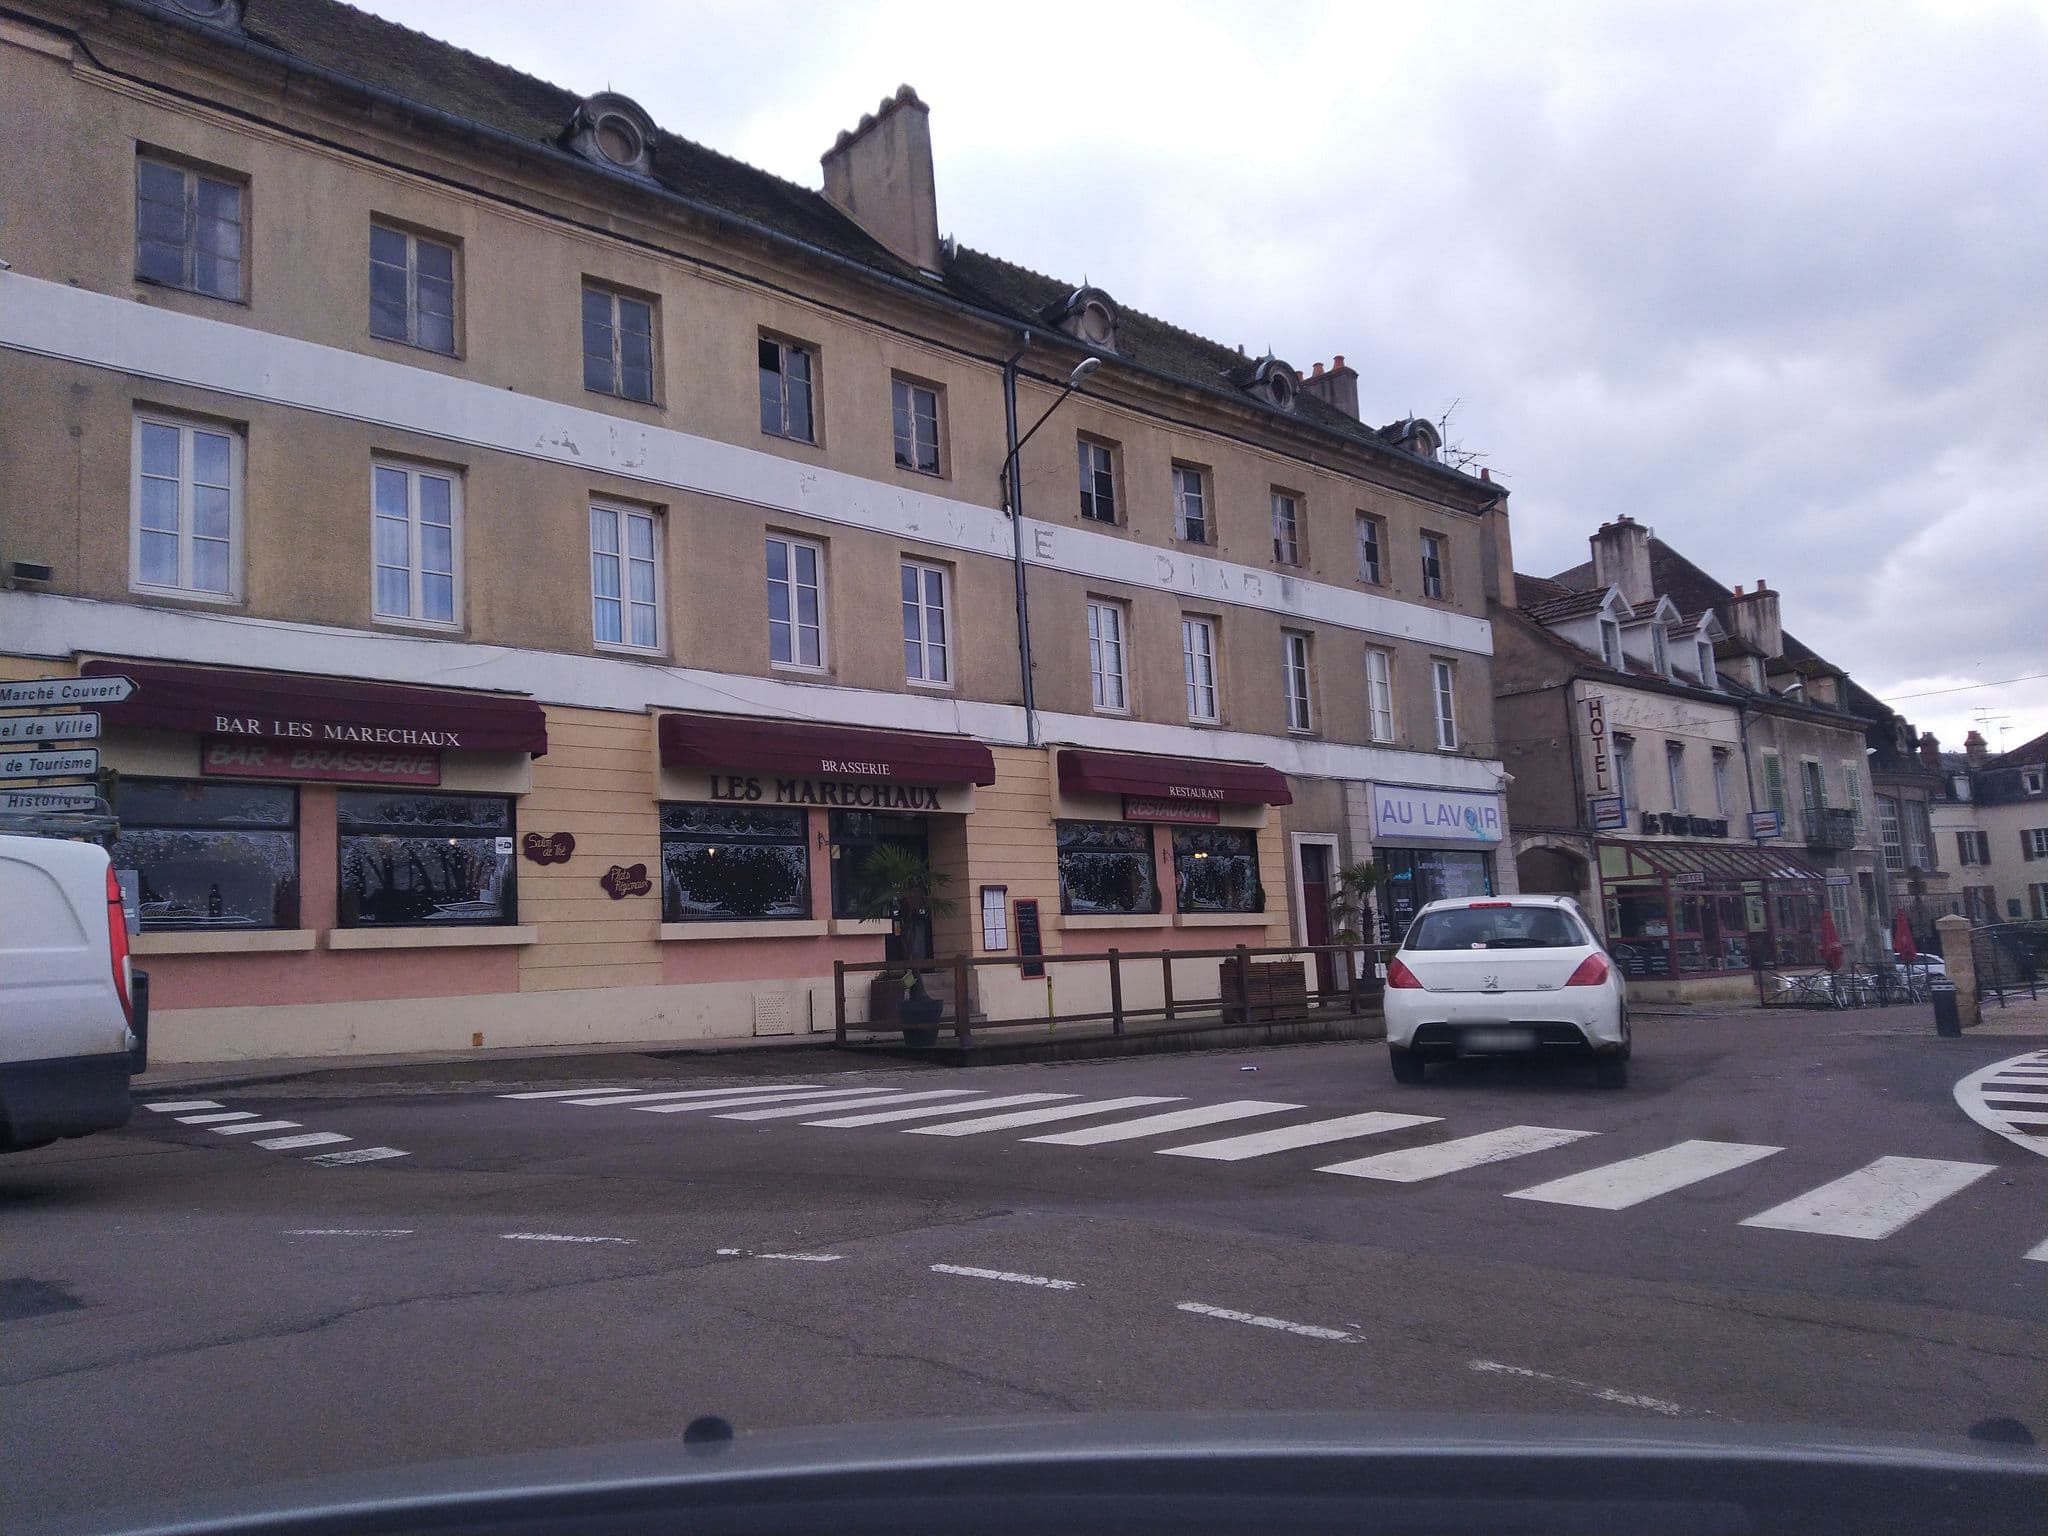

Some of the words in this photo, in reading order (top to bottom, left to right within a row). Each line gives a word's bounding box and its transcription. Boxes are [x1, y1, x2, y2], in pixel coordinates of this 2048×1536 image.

[0, 687, 54, 700] Marché
[62, 684, 121, 698] Couvert
[25, 723, 44, 734] de
[55, 721, 93, 733] Ville
[215, 716, 262, 735] BAR
[274, 720, 313, 738] LES
[324, 725, 461, 747] MARECHAUX
[1589, 701, 1608, 791] HOTEL
[6, 759, 22, 772] de
[29, 757, 92, 771] Tourisme
[209, 744, 265, 766] BAR
[290, 751, 434, 775] BRASSERIE
[821, 760, 891, 775] BRASSERIE
[710, 775, 762, 801] LES
[774, 779, 942, 810] MARECHAUX
[1169, 785, 1225, 800] RESTAURANT
[1382, 800, 1413, 824] AU
[1423, 802, 1498, 832] LAVOIR
